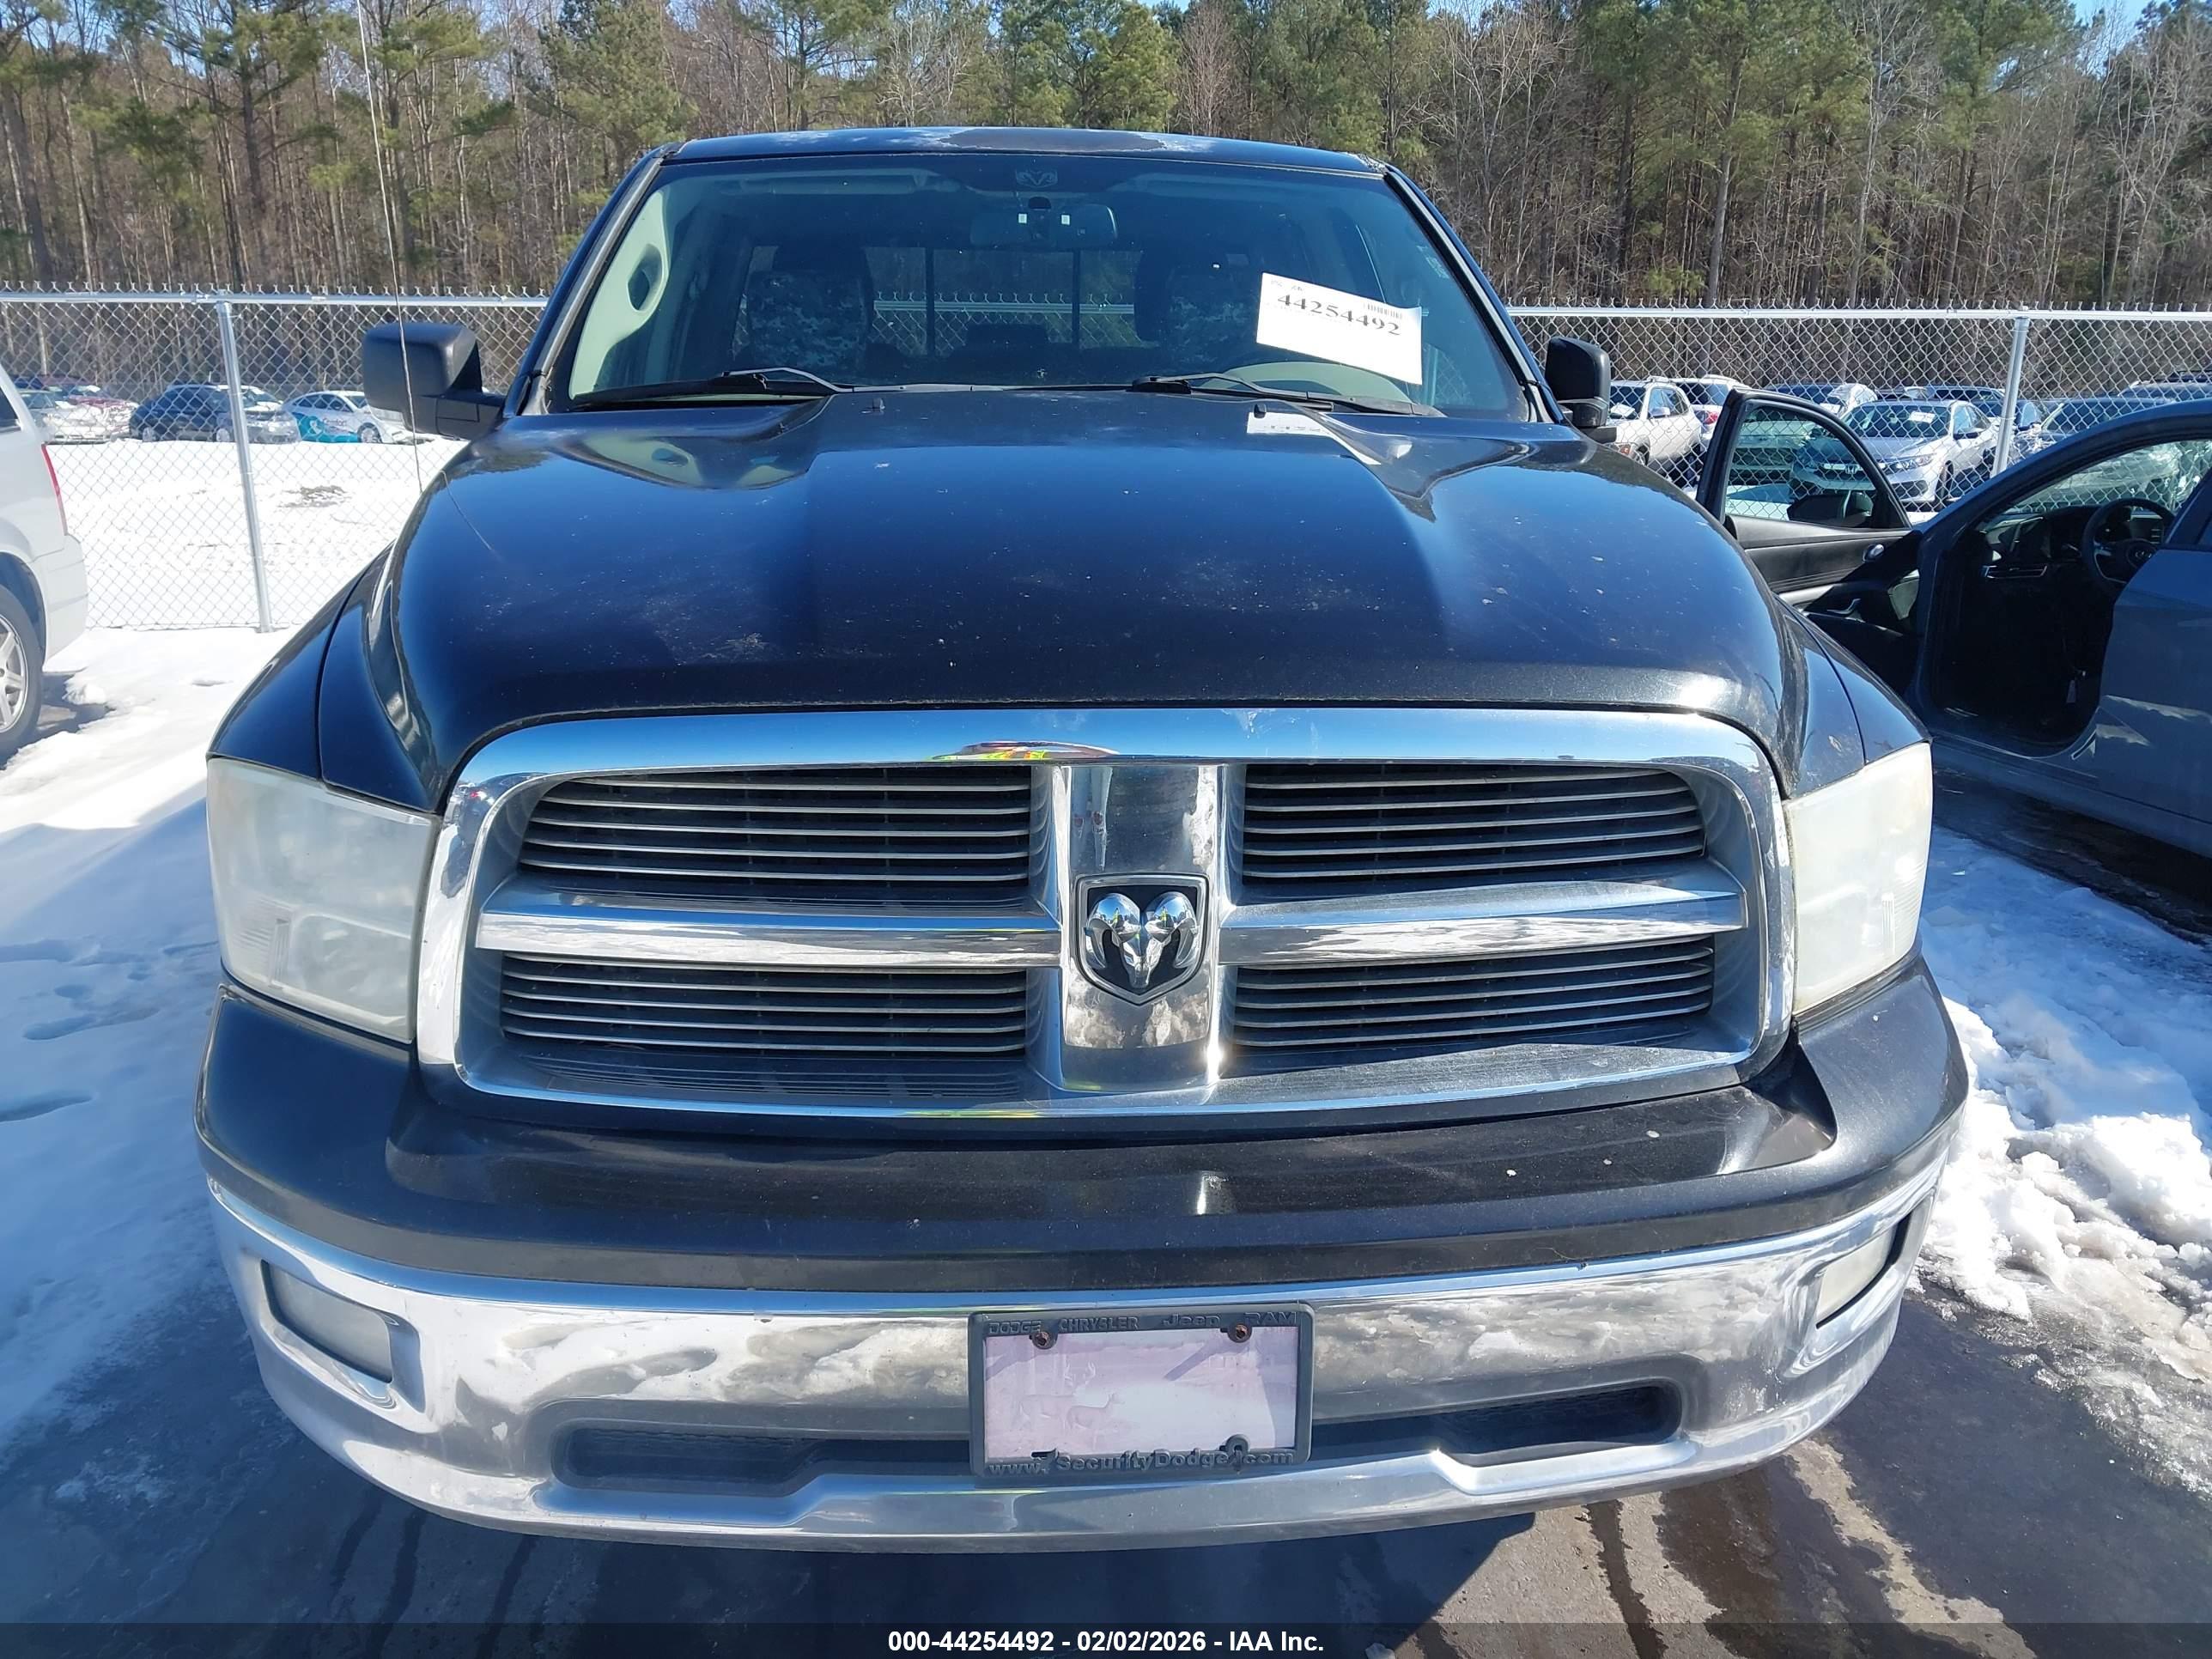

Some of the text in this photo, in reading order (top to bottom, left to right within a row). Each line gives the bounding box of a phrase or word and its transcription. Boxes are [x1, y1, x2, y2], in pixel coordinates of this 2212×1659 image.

[1277, 294, 1401, 336] 44254492
[989, 1321, 1042, 1334] DODGE
[1059, 1316, 1139, 1332] CHRYSLER
[1245, 1311, 1297, 1325] RAM
